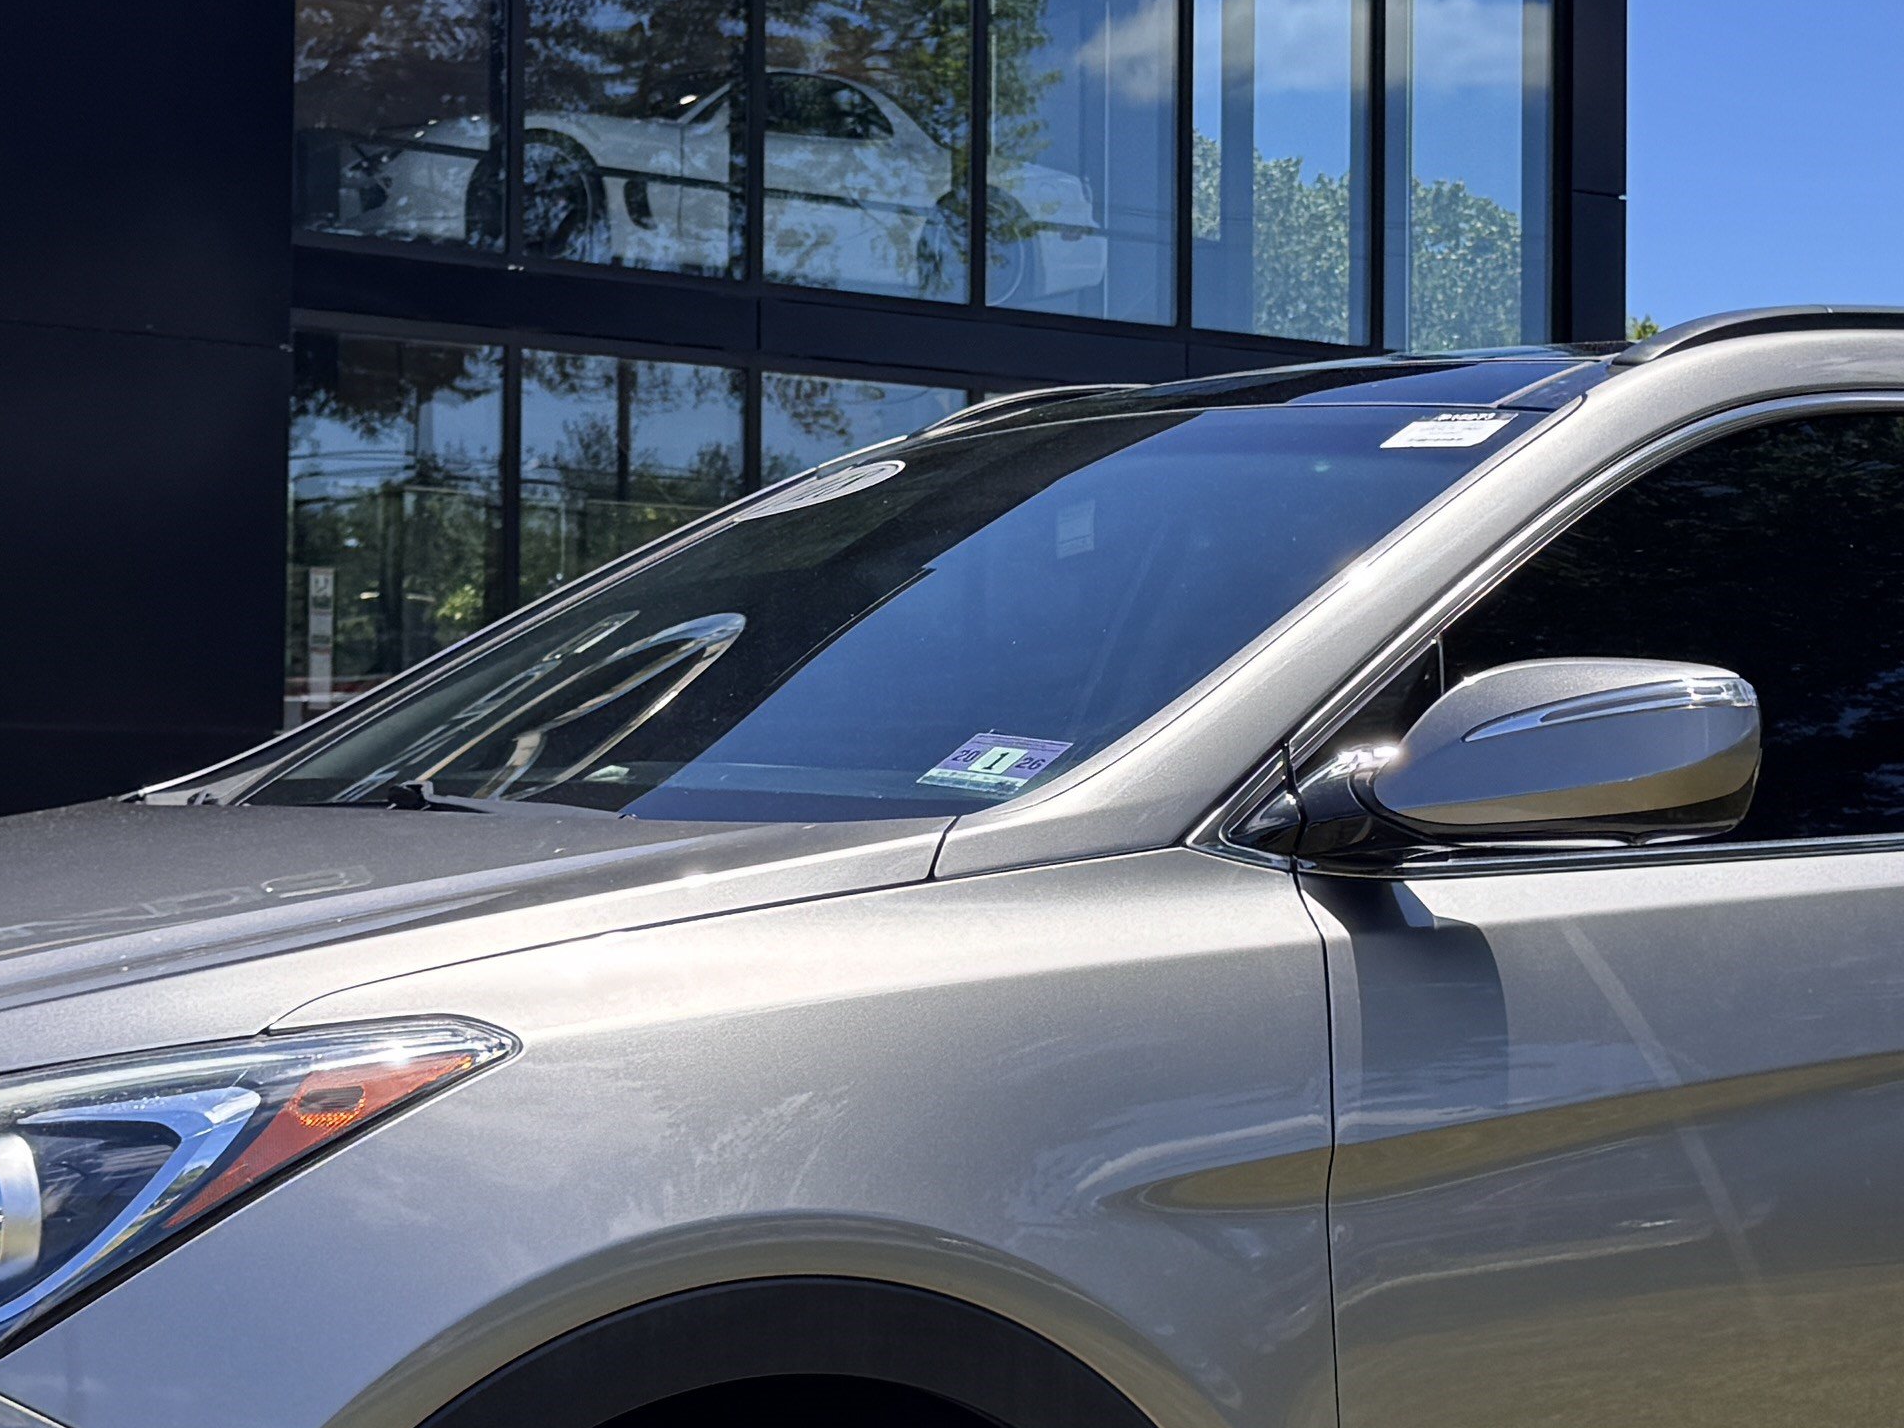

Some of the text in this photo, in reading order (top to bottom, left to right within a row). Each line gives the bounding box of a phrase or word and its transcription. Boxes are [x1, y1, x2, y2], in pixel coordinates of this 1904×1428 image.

[951, 749, 1046, 771] 20 1 26
